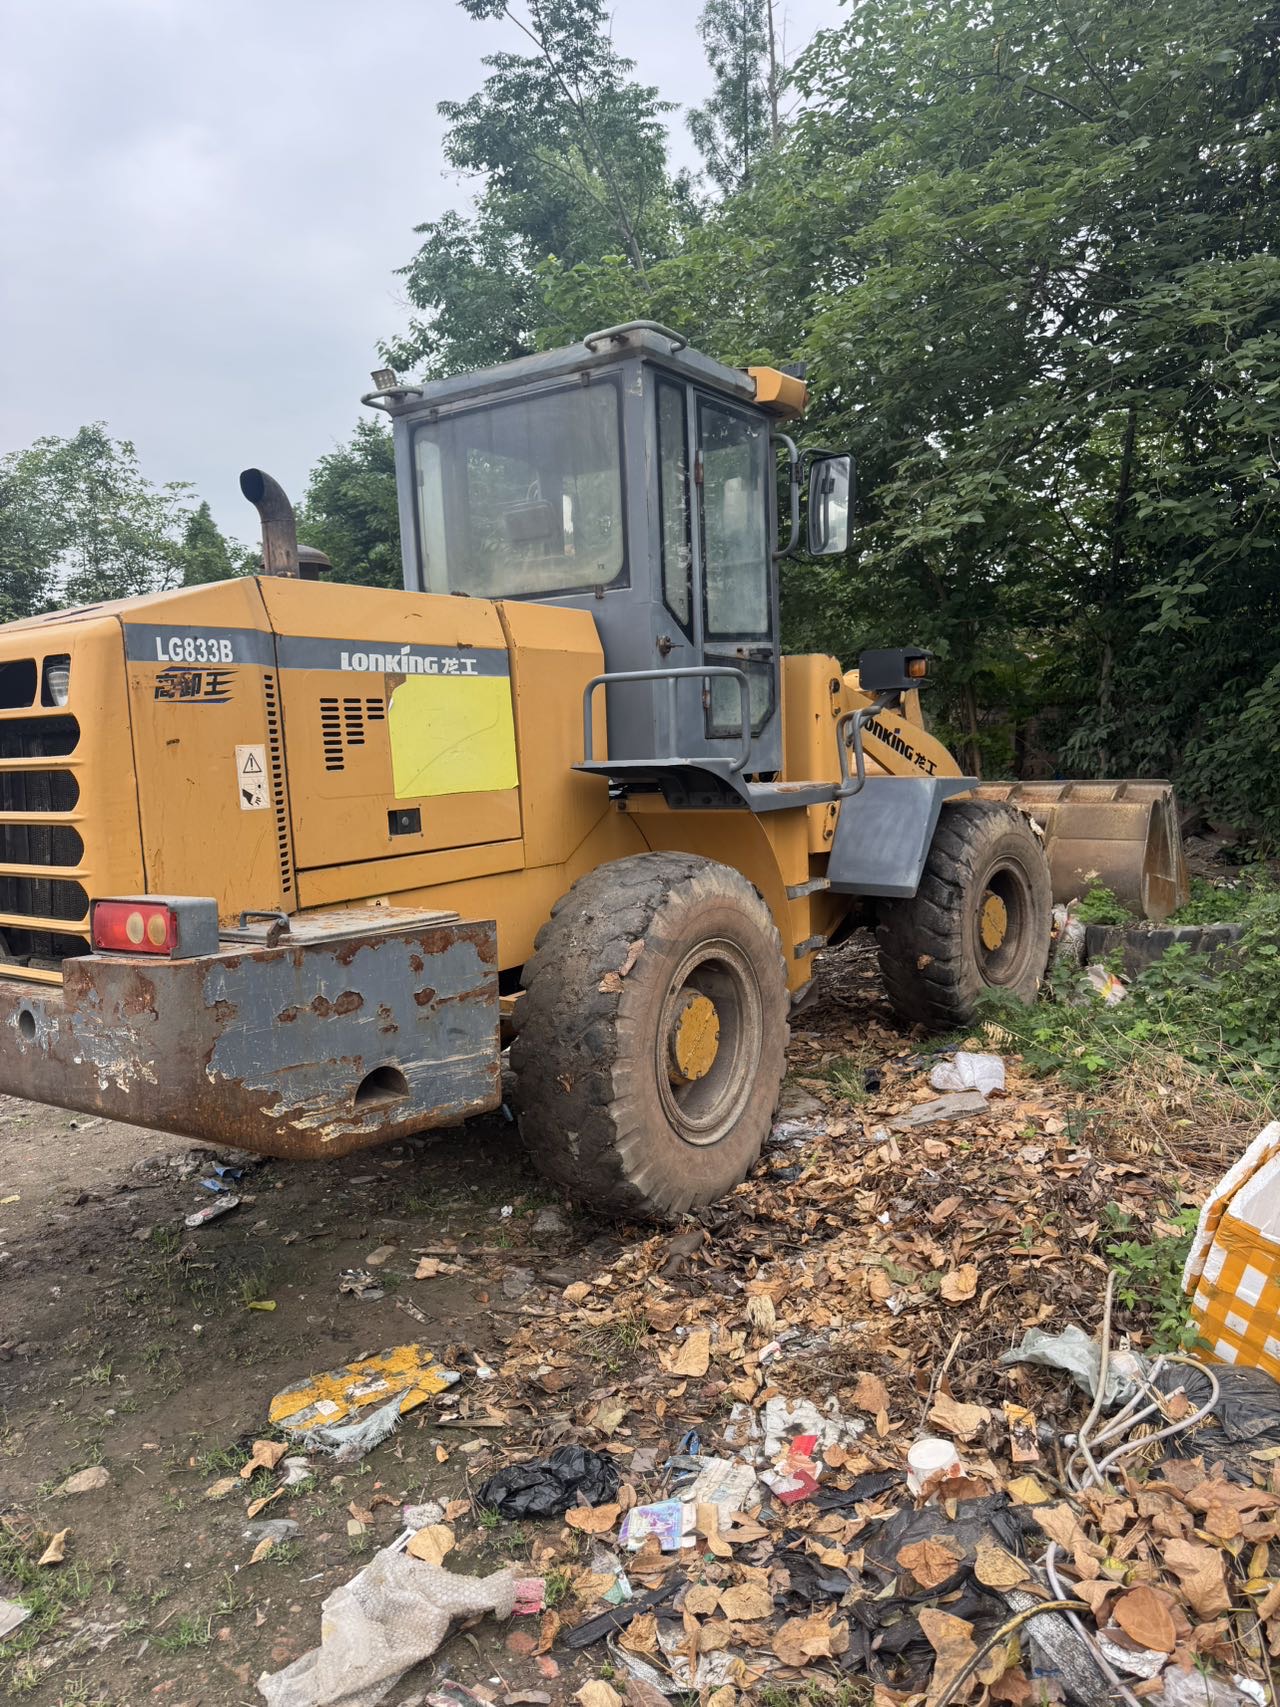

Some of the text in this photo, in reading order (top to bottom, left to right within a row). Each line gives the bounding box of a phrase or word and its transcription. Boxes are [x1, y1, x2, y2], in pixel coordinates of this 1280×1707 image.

[155, 636, 233, 663] LG833B
[441, 657, 479, 675] 龙工
[915, 752, 938, 776] 龙工
